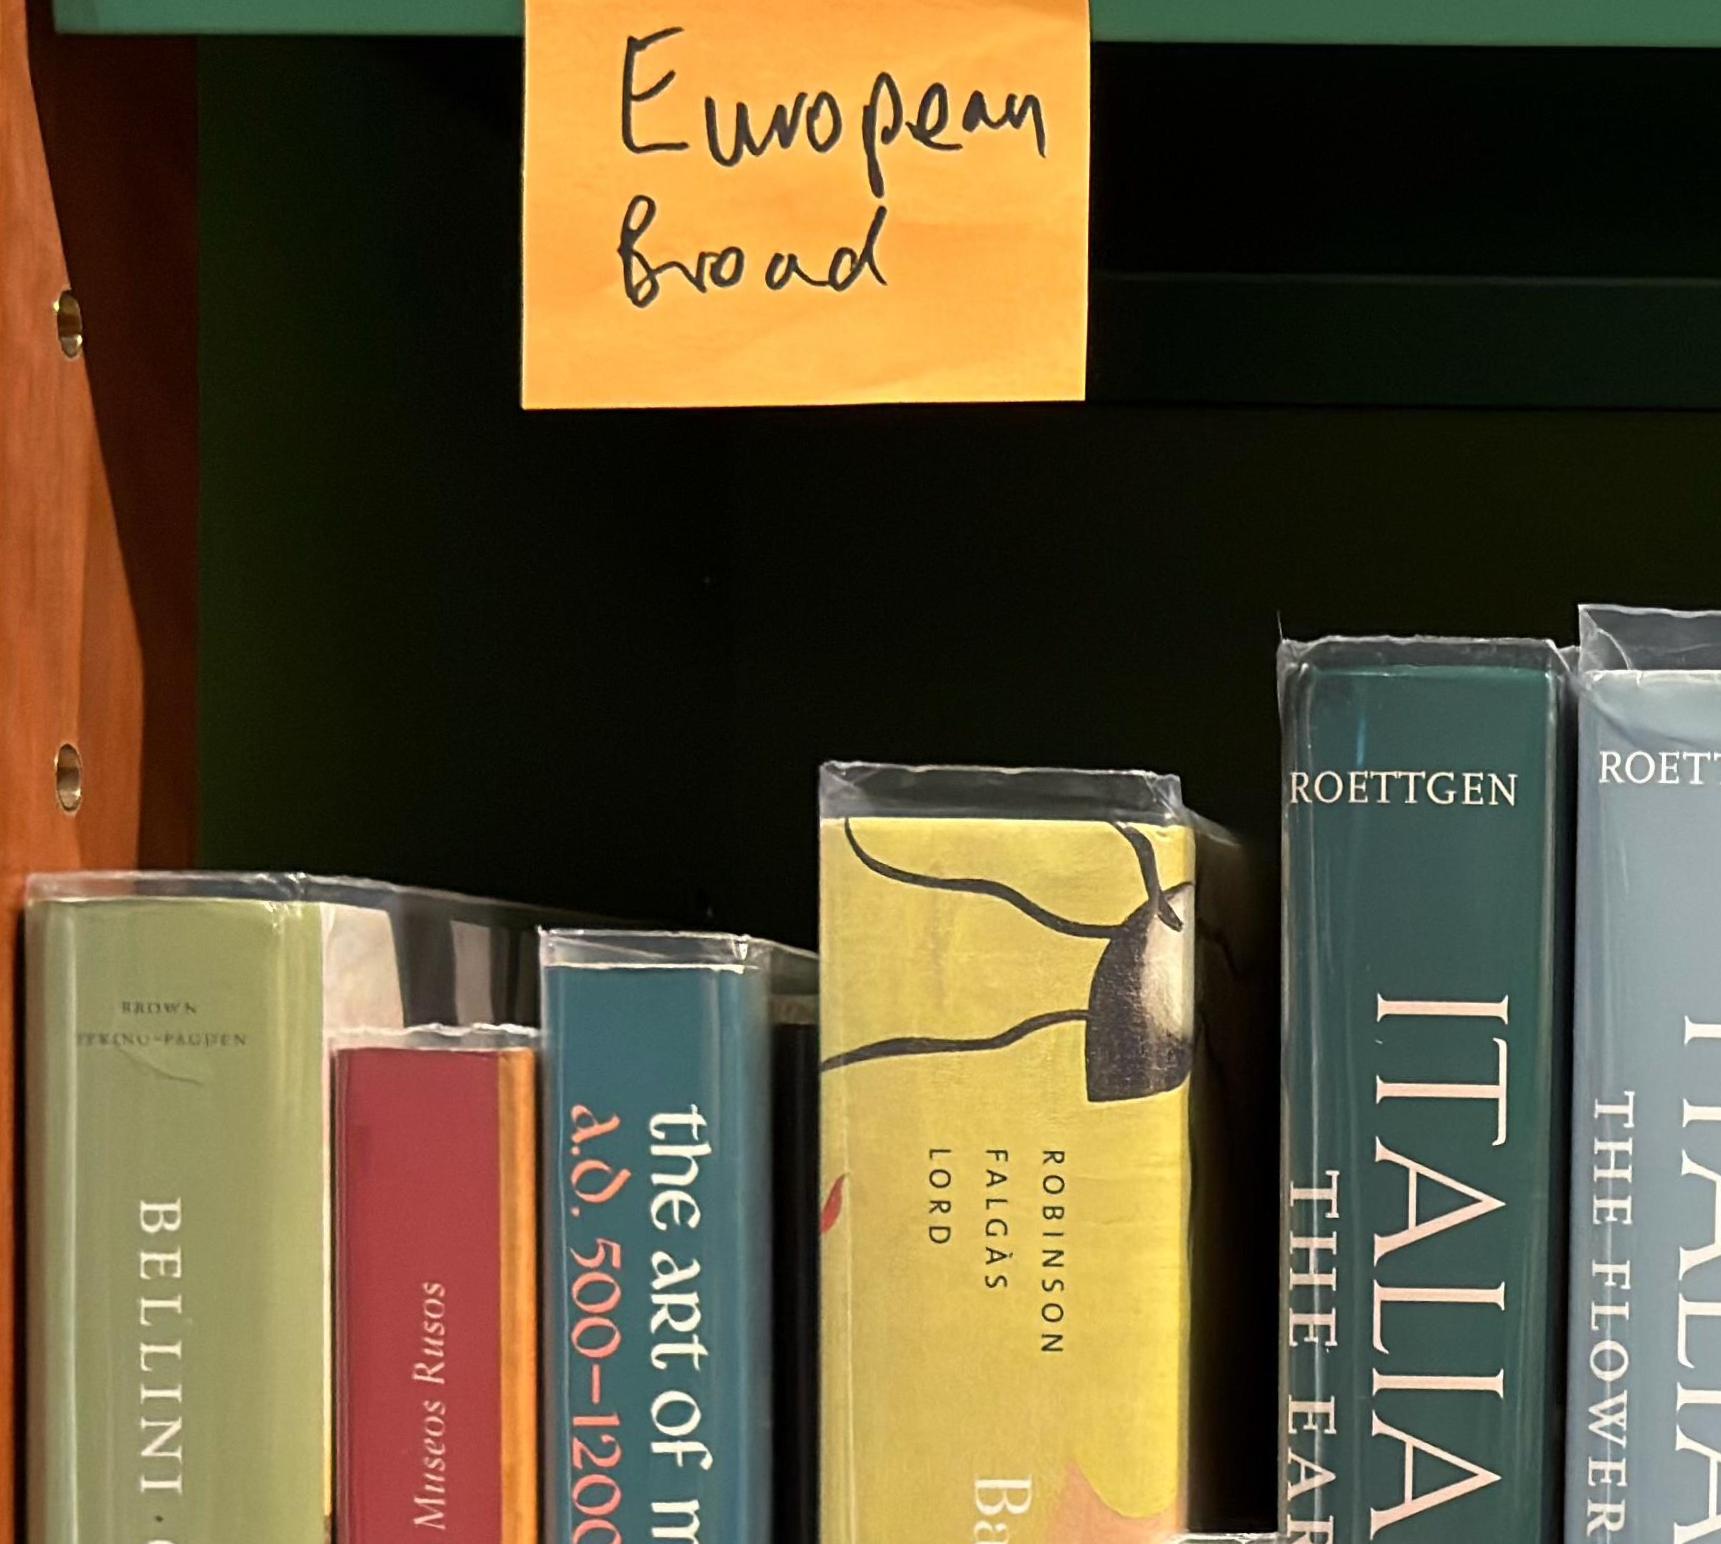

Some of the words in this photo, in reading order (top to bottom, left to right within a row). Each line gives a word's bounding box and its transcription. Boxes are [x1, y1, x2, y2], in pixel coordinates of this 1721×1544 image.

[623, 28, 1046, 199] European
[618, 190, 888, 309] Broad
[1292, 773, 1519, 808] ROETTGEN
[651, 1105, 712, 1231] the
[930, 1150, 952, 1245] LORD
[986, 1151, 1014, 1289] FALGÀS
[1042, 1152, 1066, 1352] ROBINSON
[1289, 1170, 1341, 1347] THE
[141, 1199, 183, 1494] BELLINI
[414, 1284, 446, 1385] Rusos
[415, 1402, 446, 1530] Museos
[652, 1392, 714, 1471] of
